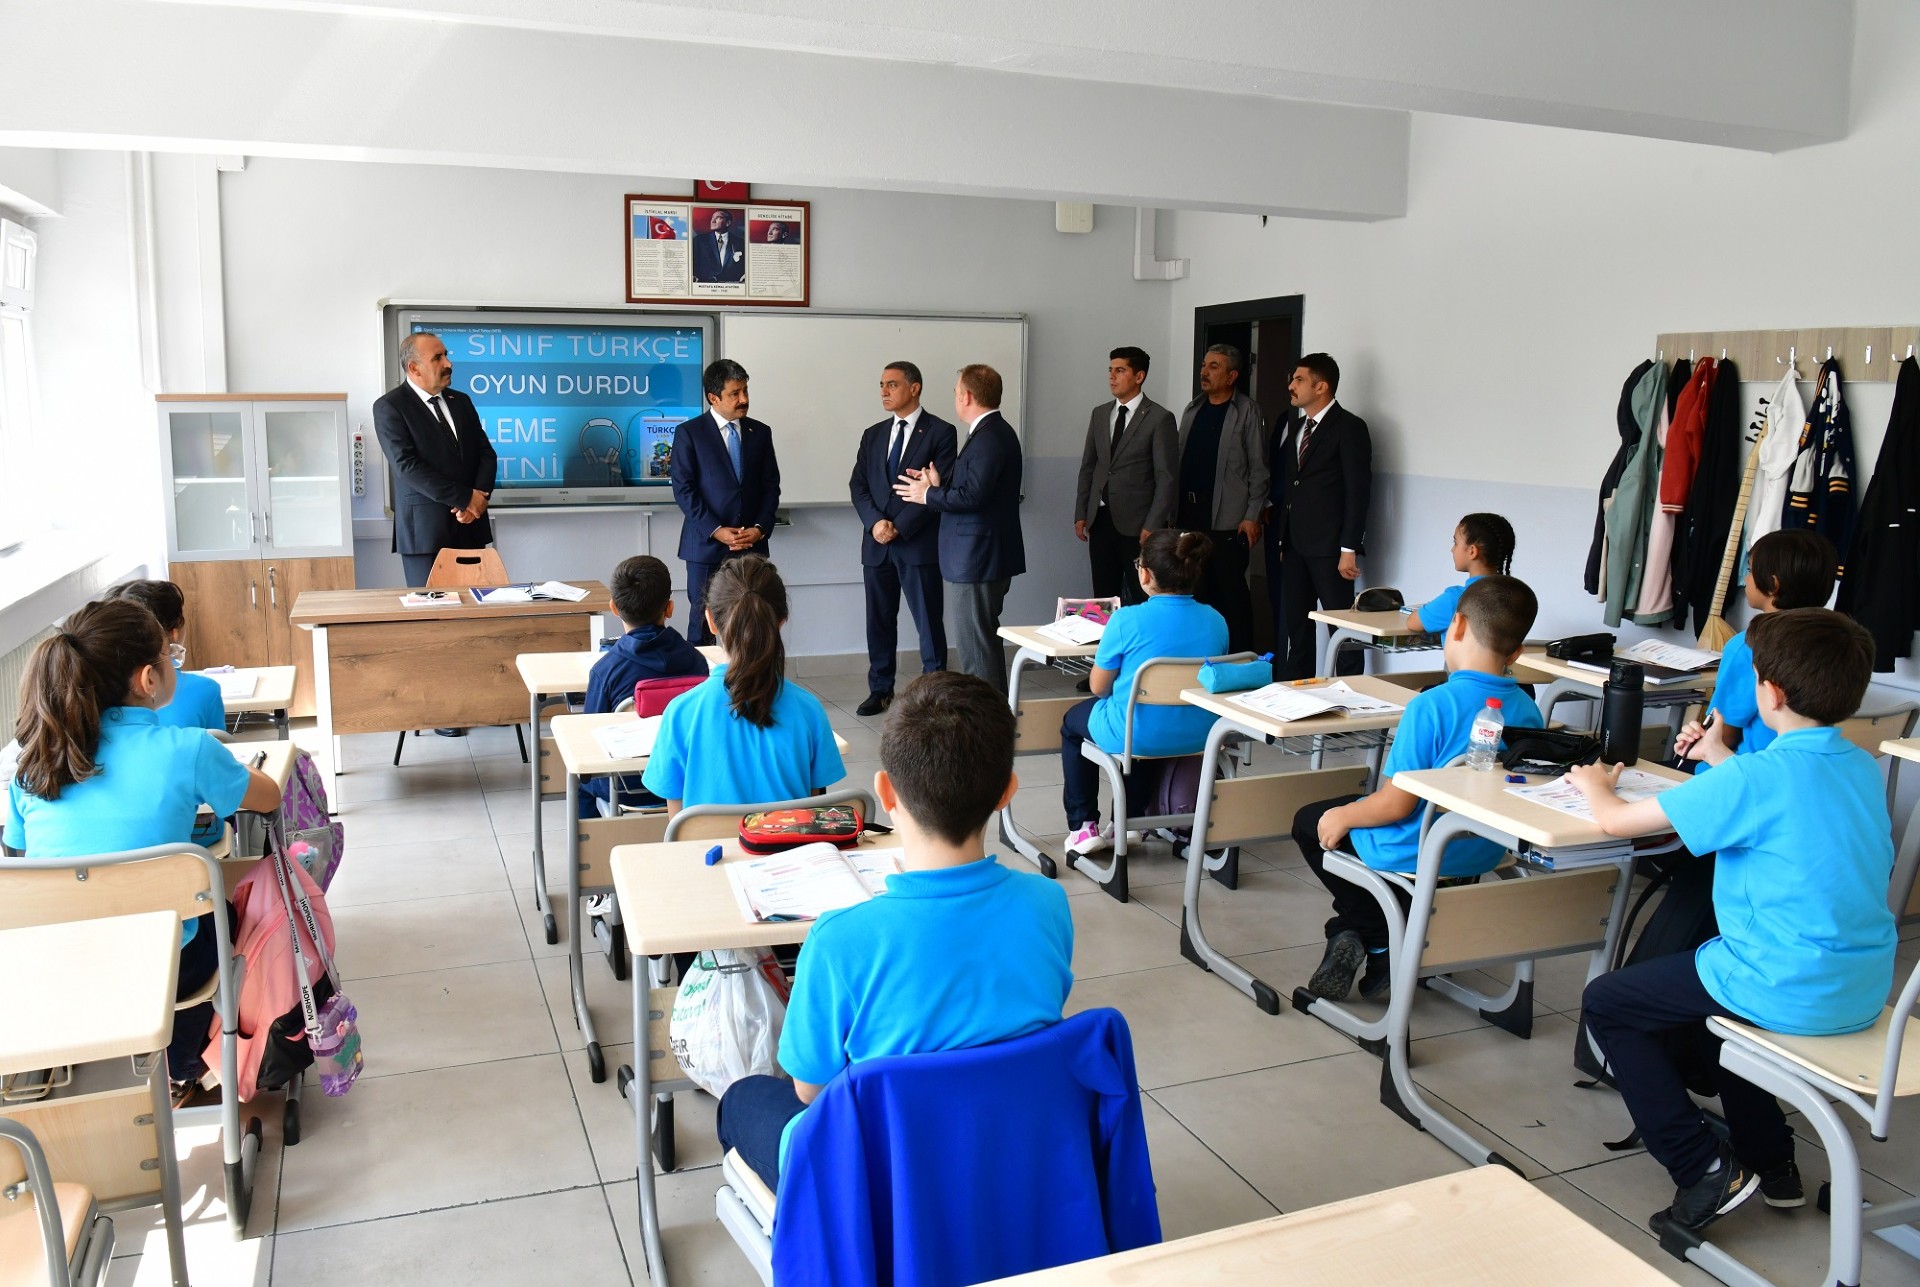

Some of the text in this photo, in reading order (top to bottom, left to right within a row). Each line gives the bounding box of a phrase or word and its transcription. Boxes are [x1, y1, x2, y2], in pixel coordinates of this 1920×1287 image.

[468, 333, 554, 356] SINIF
[566, 331, 689, 363] TÜRKÇE
[469, 374, 650, 395] OYUN DURDU
[480, 417, 557, 443] LEME
[646, 424, 676, 436] TÜRKÇ
[496, 452, 558, 479] TNİ
[301, 984, 315, 1021] MORHOPE
